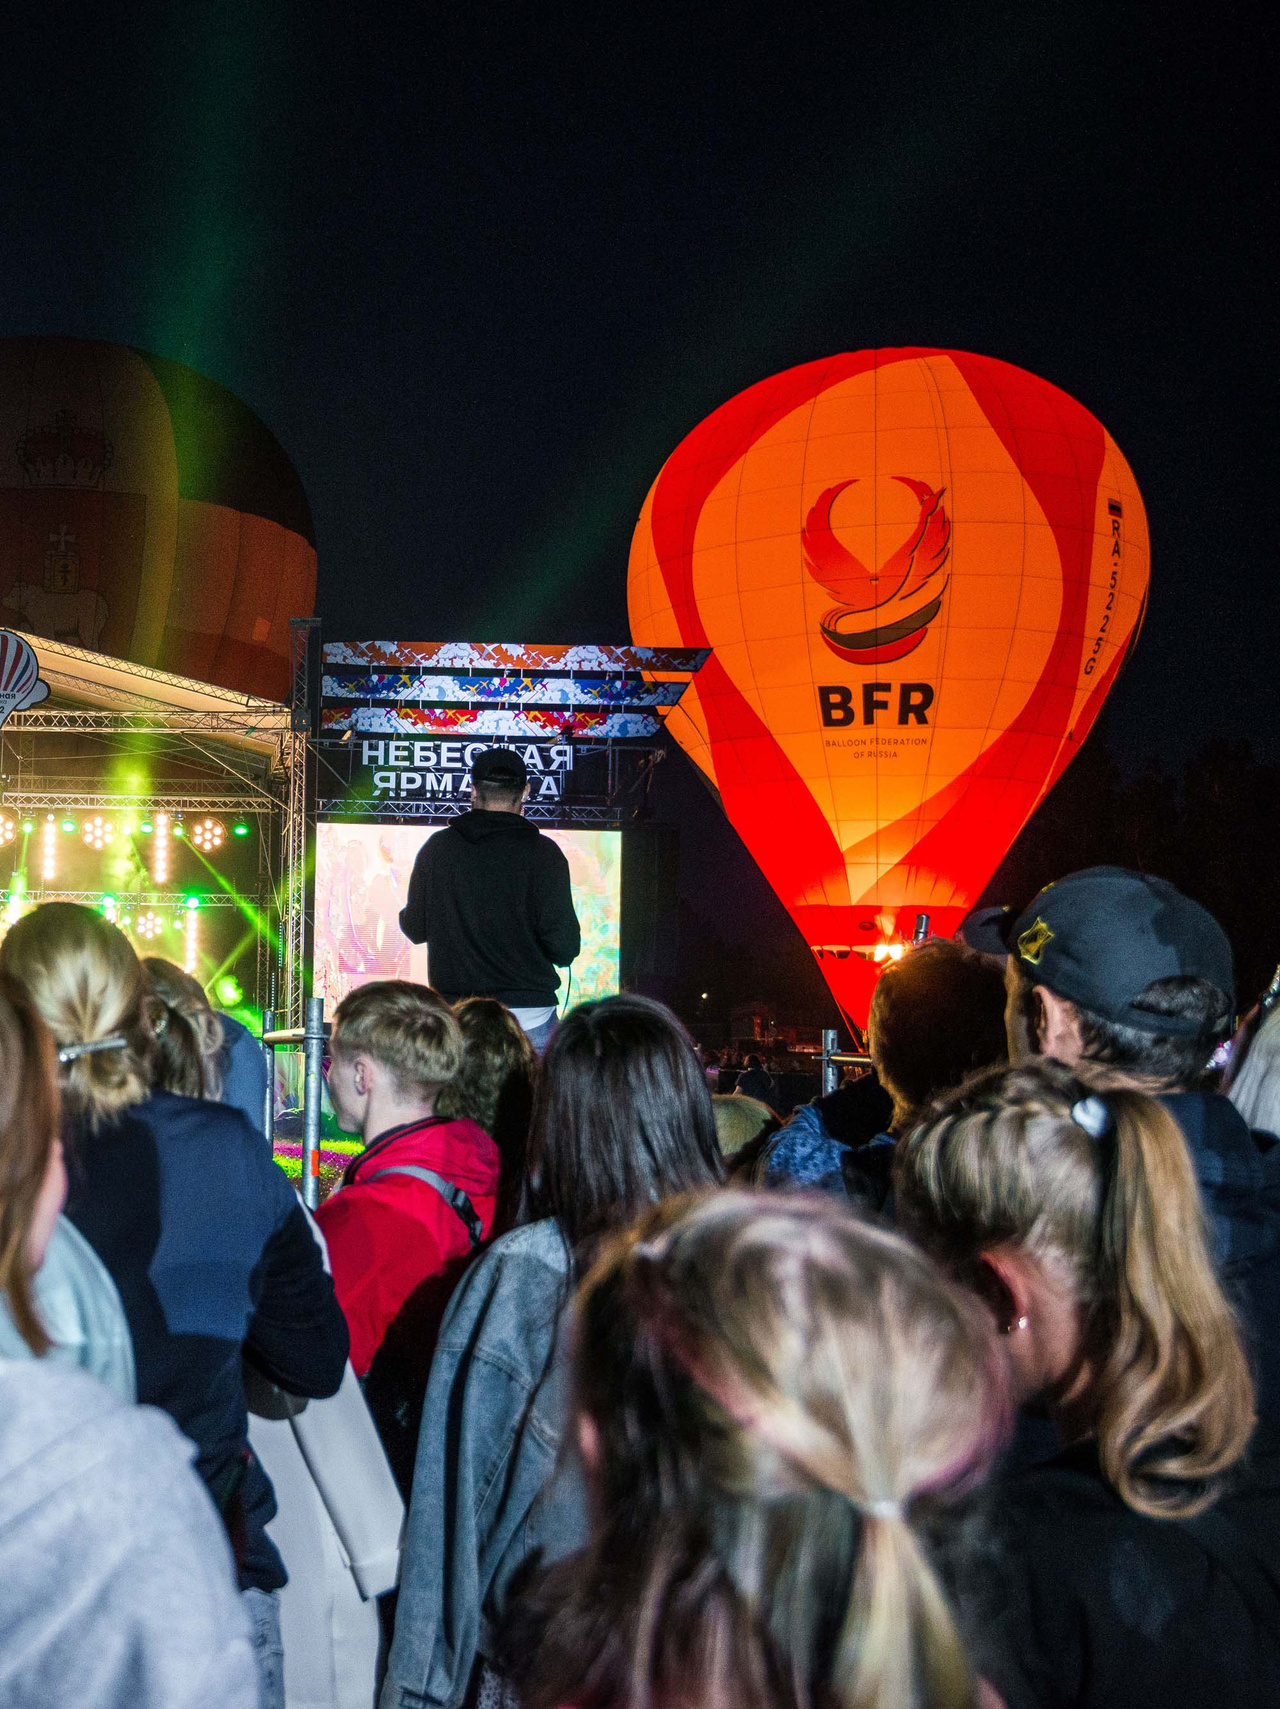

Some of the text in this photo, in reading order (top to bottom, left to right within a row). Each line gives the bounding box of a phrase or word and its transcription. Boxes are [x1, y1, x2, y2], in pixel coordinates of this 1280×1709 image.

[818, 682, 934, 727] BFR
[362, 740, 573, 771] НЕБЕСАЯ
[825, 738, 928, 748] BALLOON FEDERATION
[853, 751, 898, 759] OF RUSSIA
[373, 771, 561, 800] ЯРМАА
